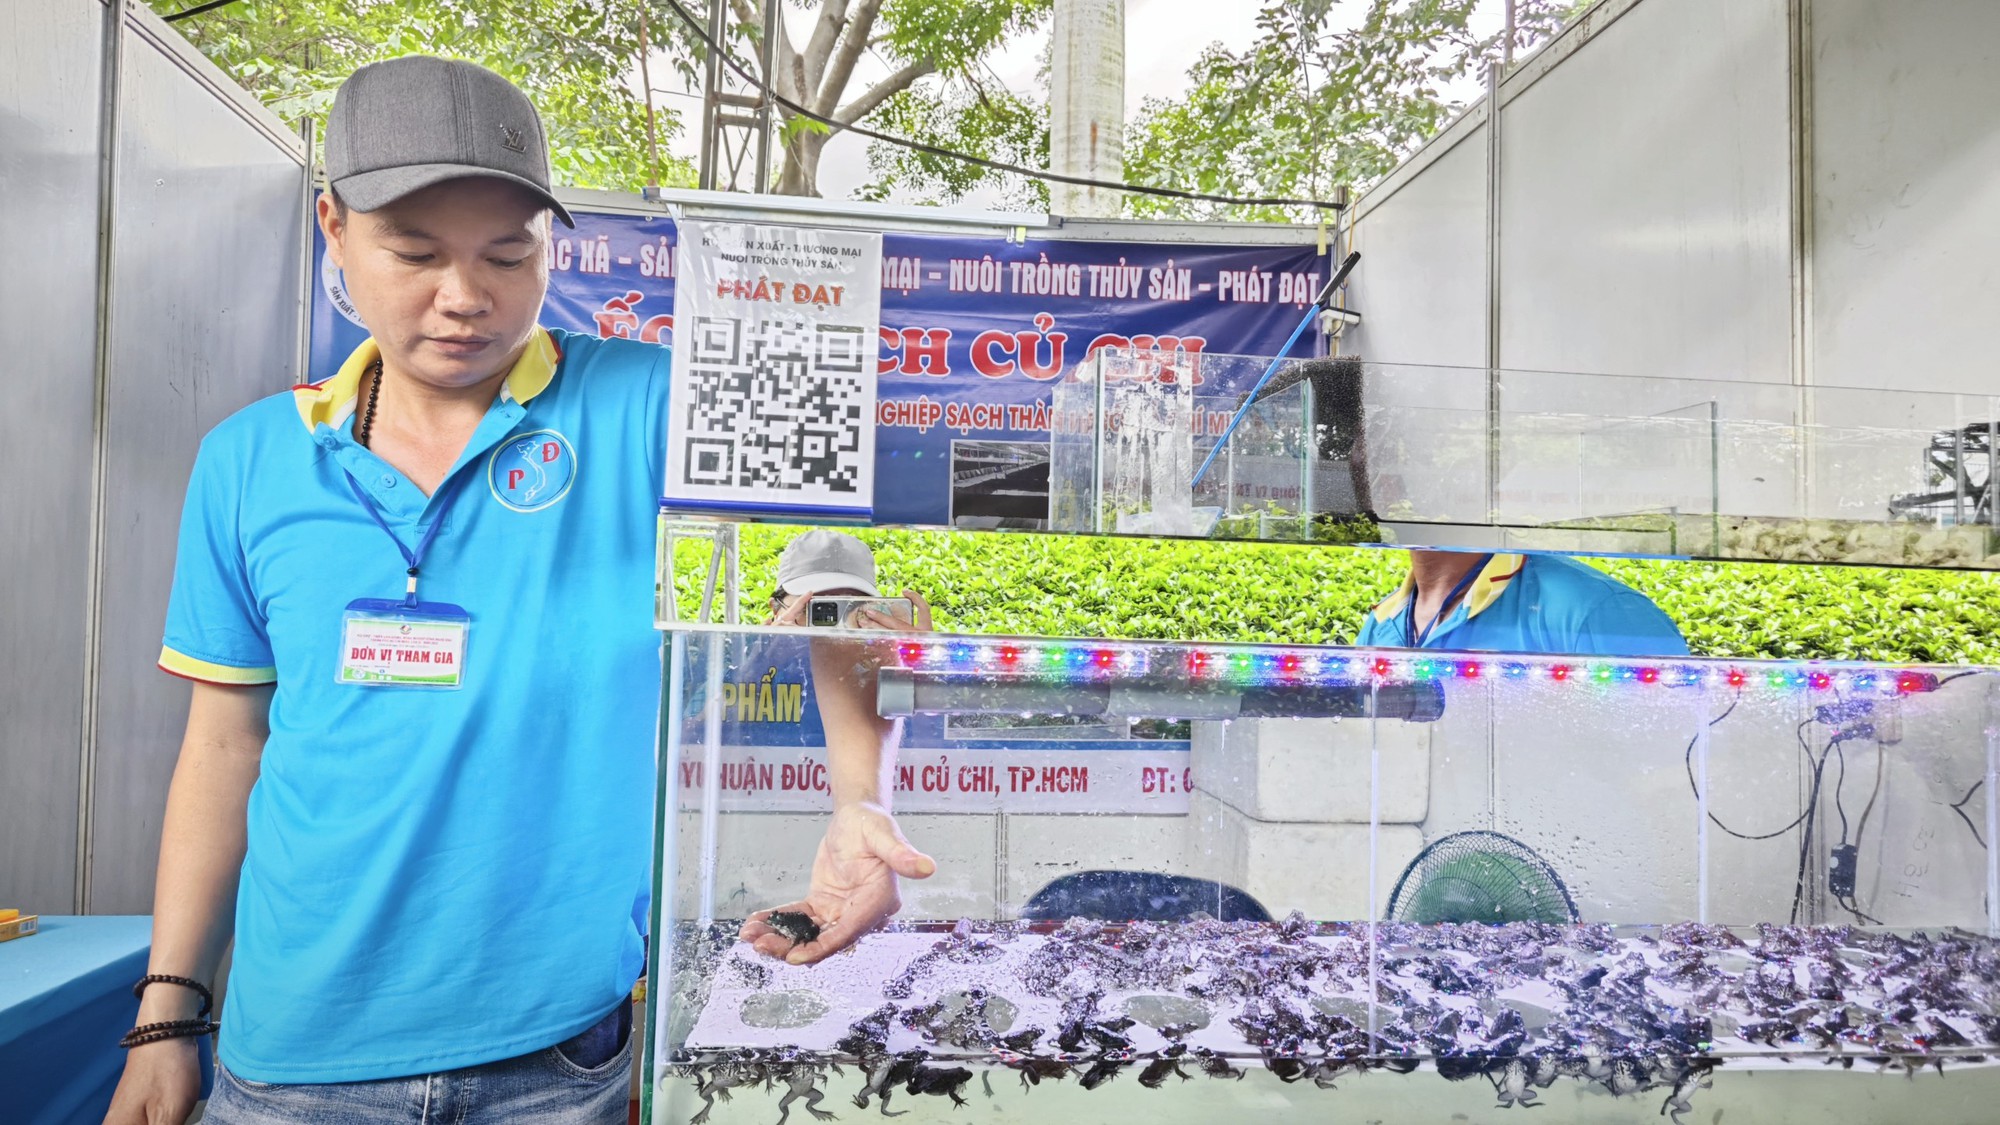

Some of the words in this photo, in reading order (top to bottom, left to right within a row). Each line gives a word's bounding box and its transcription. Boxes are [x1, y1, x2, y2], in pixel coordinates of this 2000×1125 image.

[841, 247, 862, 259] MẠI
[579, 235, 610, 273] XÃ
[882, 257, 920, 296] MẠI
[949, 255, 1002, 293] NUÔI
[1010, 252, 1081, 297] TRỒNG
[1088, 257, 1143, 299] THỦY
[1148, 259, 1192, 301] SẢN
[1218, 265, 1273, 303] PHÁT
[1278, 272, 1320, 310] ĐẠT
[792, 283, 846, 311] ĐẠT
[969, 311, 1069, 381] CỦ
[945, 401, 1003, 435] SẠCH
[351, 646, 376, 660] ĐƠN
[380, 649, 392, 665] VỊ
[396, 650, 431, 663] THAM
[434, 652, 453, 664] GIA
[721, 666, 801, 723] PHẨM
[781, 757, 832, 796] ĐỨC,
[921, 755, 950, 792] CỦ
[958, 766, 1000, 797] CHI,
[1007, 766, 1089, 793] TP.HCM
[1142, 766, 1175, 793] ĐT:
